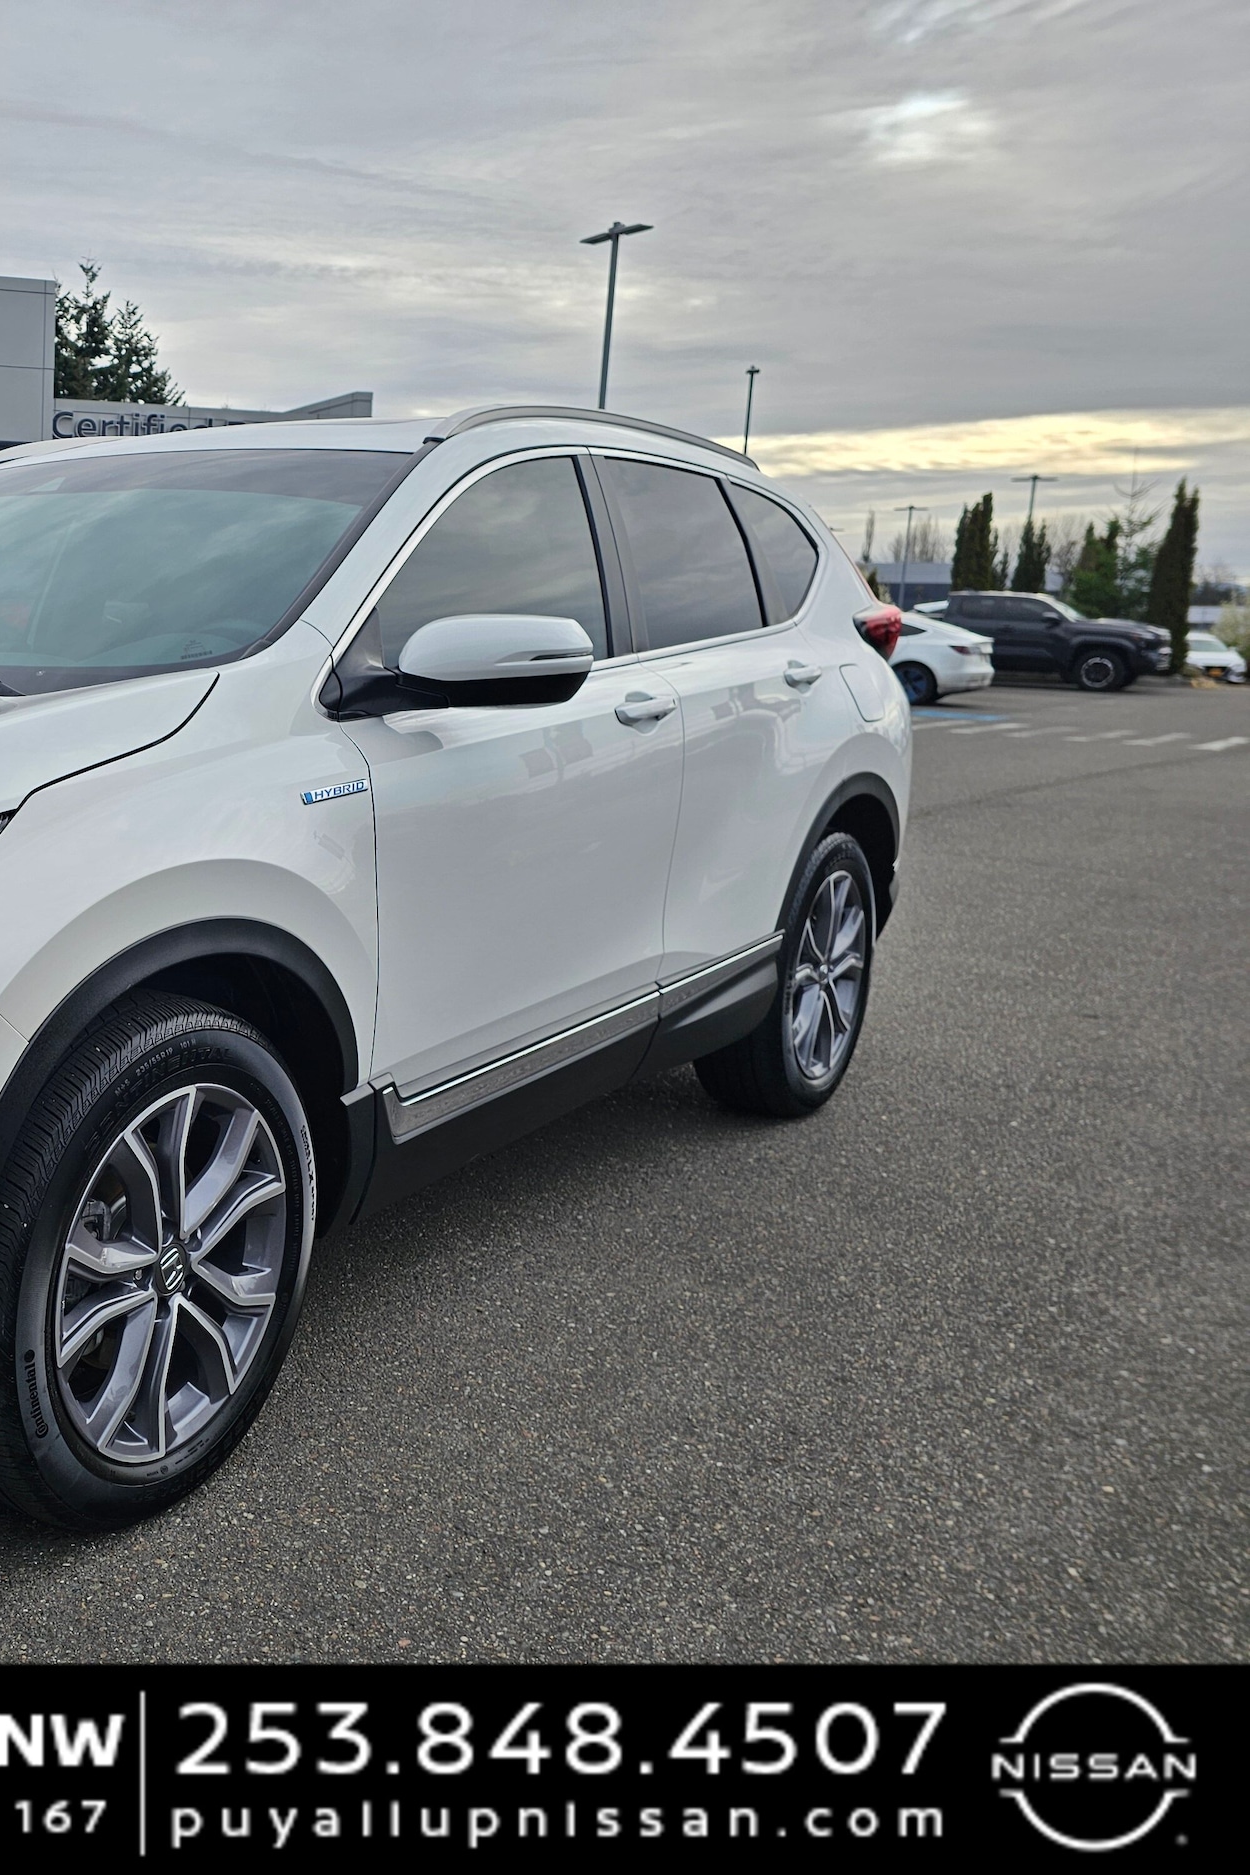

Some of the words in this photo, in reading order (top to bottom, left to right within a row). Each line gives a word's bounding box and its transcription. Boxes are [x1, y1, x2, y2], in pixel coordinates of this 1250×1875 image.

[314, 781, 365, 801] HYBRID
[135, 1046, 174, 1077] 235/55R19
[24, 1361, 49, 1439] Continental
